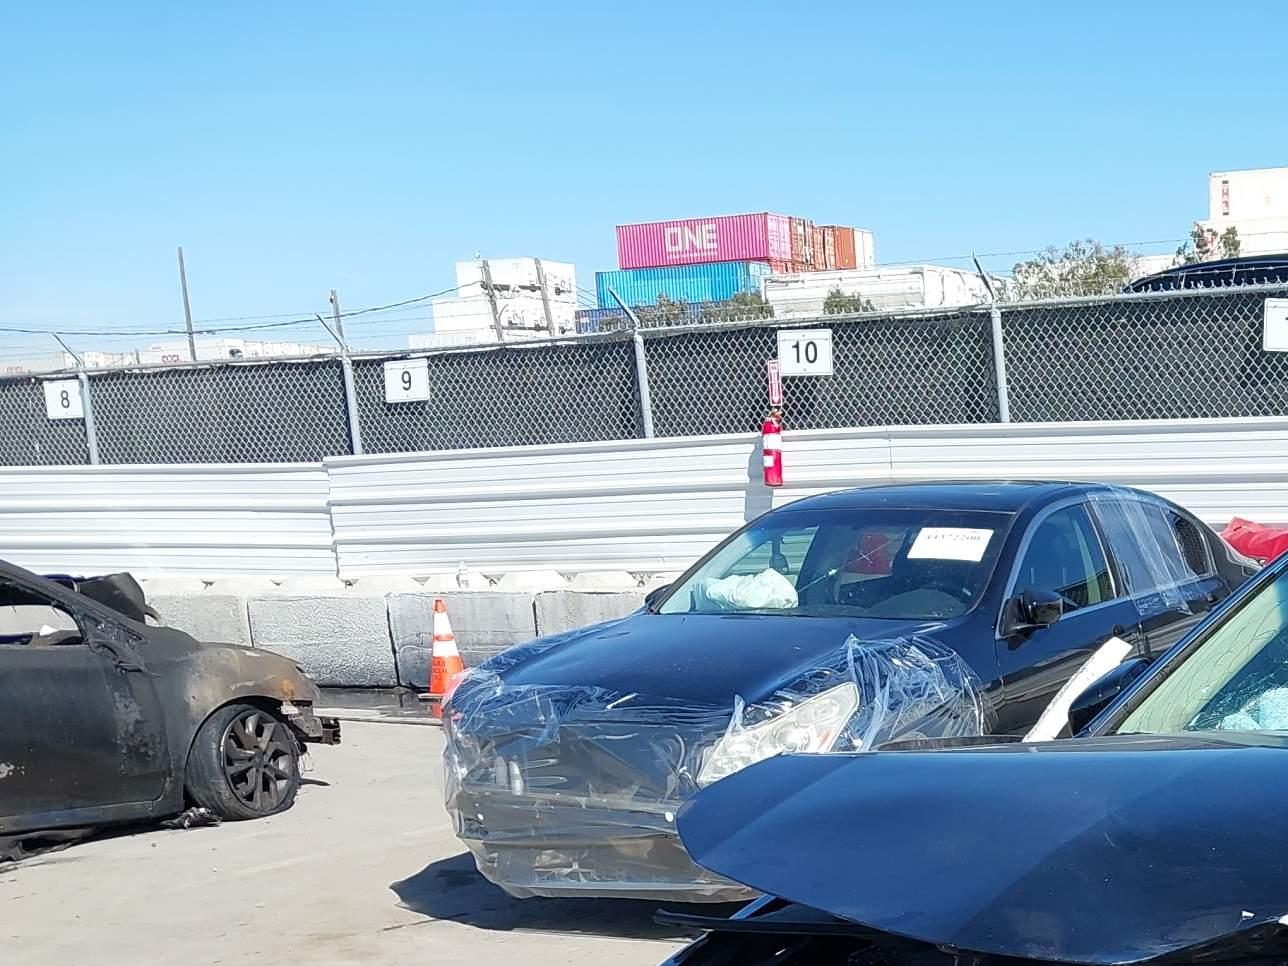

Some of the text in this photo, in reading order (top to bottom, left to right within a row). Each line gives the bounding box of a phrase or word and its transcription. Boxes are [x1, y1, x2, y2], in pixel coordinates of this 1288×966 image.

[664, 223, 718, 252] ONE
[792, 340, 818, 364] 10
[401, 369, 412, 392] 9
[60, 390, 70, 409] 8
